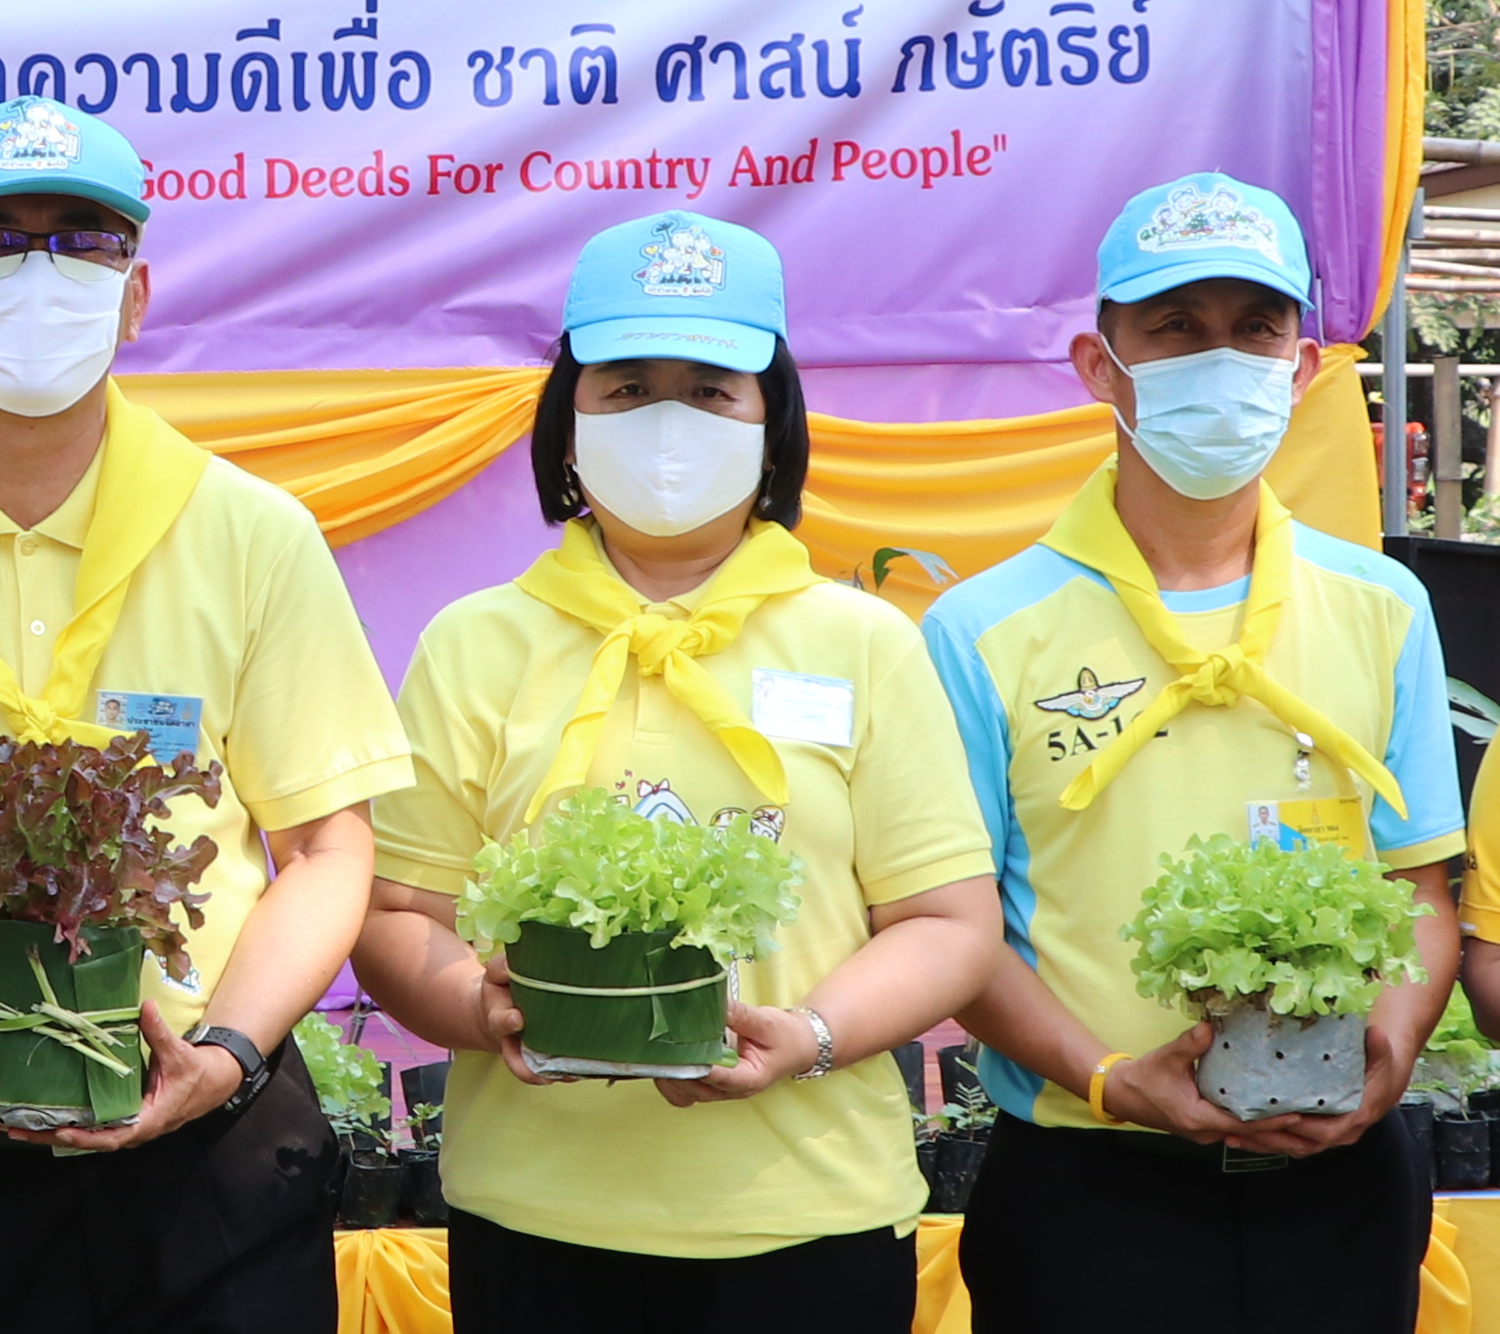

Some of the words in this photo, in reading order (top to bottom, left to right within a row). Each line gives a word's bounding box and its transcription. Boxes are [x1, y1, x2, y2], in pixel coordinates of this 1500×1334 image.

[467, 23, 618, 106] ชาติ
[655, 4, 862, 102] ศาสน์
[264, 150, 411, 199] Deeds
[427, 153, 505, 196] For
[519, 151, 710, 200] Country
[728, 137, 820, 188] And
